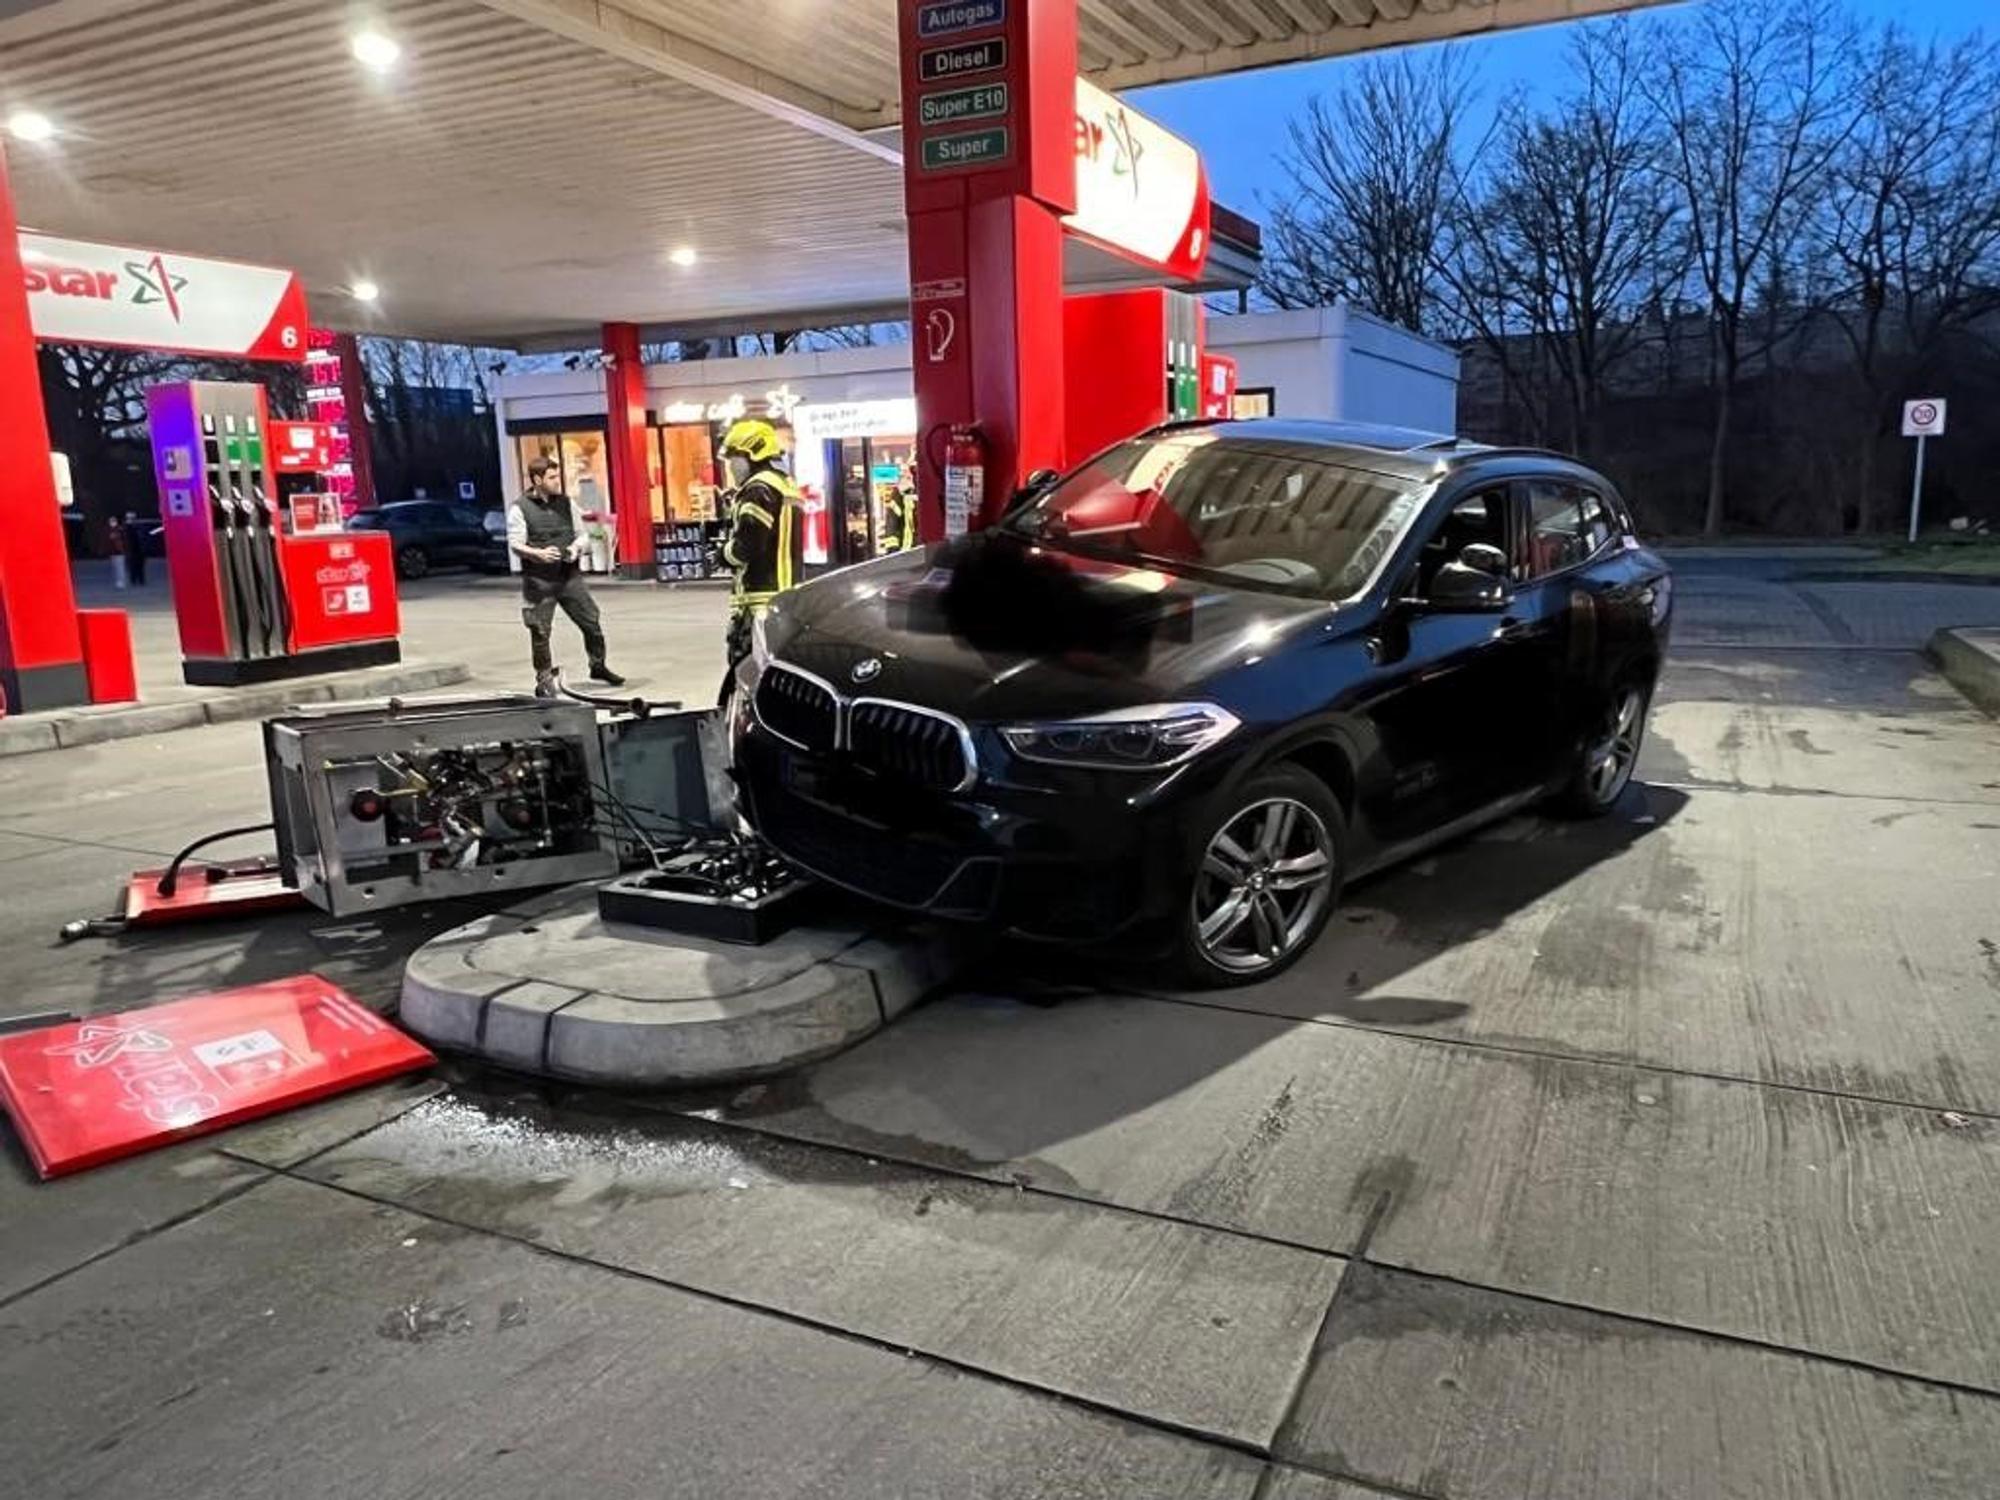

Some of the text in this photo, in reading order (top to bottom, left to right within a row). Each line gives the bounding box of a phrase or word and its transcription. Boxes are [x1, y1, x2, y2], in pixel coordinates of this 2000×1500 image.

[928, 3, 996, 29] Autogas
[936, 45, 990, 71] Diesel
[924, 91, 1002, 119] Super E10
[938, 137, 990, 159] Super
[281, 326, 298, 347] 6
